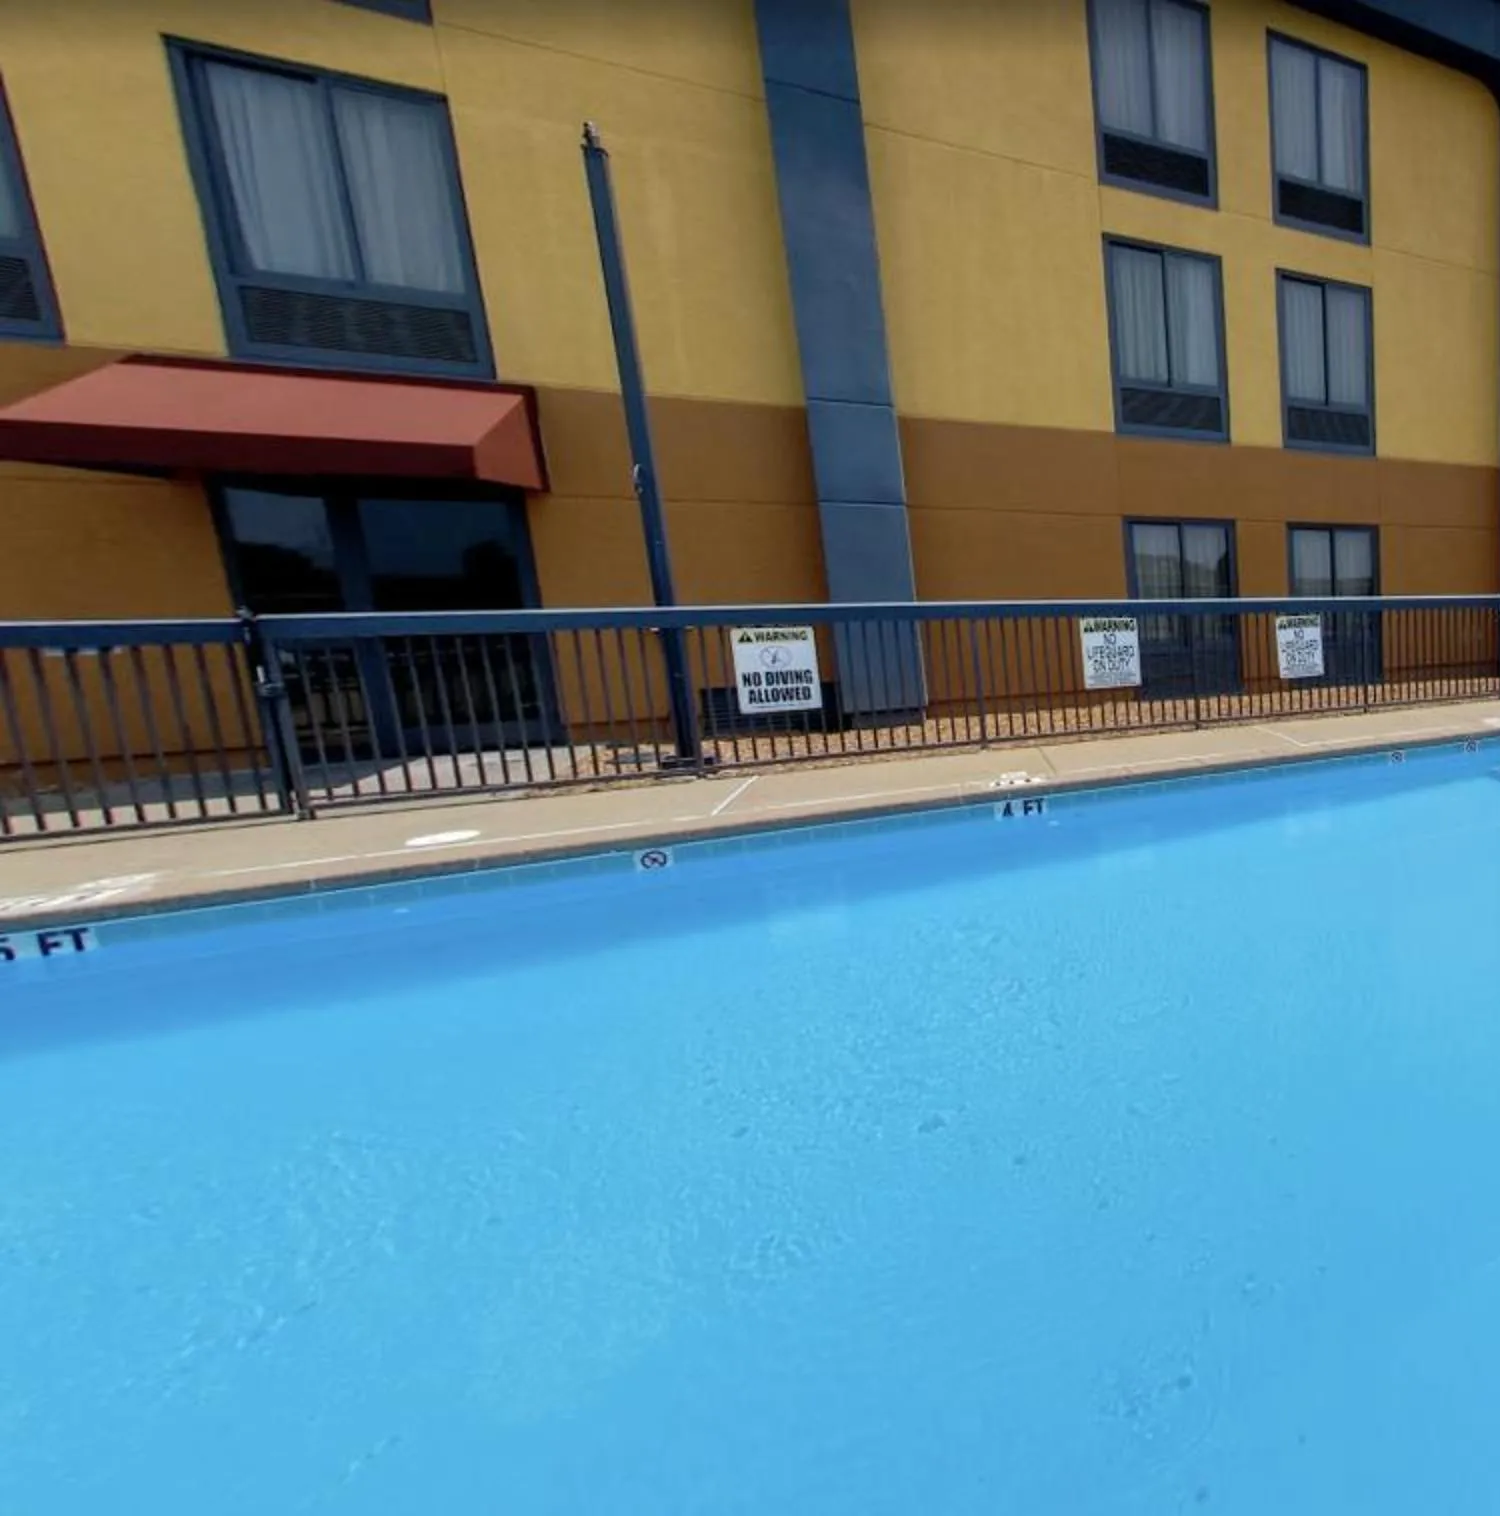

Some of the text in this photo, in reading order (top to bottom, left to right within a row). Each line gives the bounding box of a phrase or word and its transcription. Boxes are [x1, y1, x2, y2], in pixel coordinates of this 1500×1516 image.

[1093, 619, 1134, 632] WARNING
[754, 630, 808, 642] WARNING
[1103, 633, 1117, 645] NO
[1293, 629, 1305, 640] NO
[1087, 645, 1135, 659] LIFEGUARD
[1093, 657, 1131, 672] ON DUTY
[742, 669, 813, 687] NO DIVING
[748, 686, 812, 704] ALLOWED
[1003, 798, 1044, 817] 4 FT
[36, 927, 89, 957] FT
